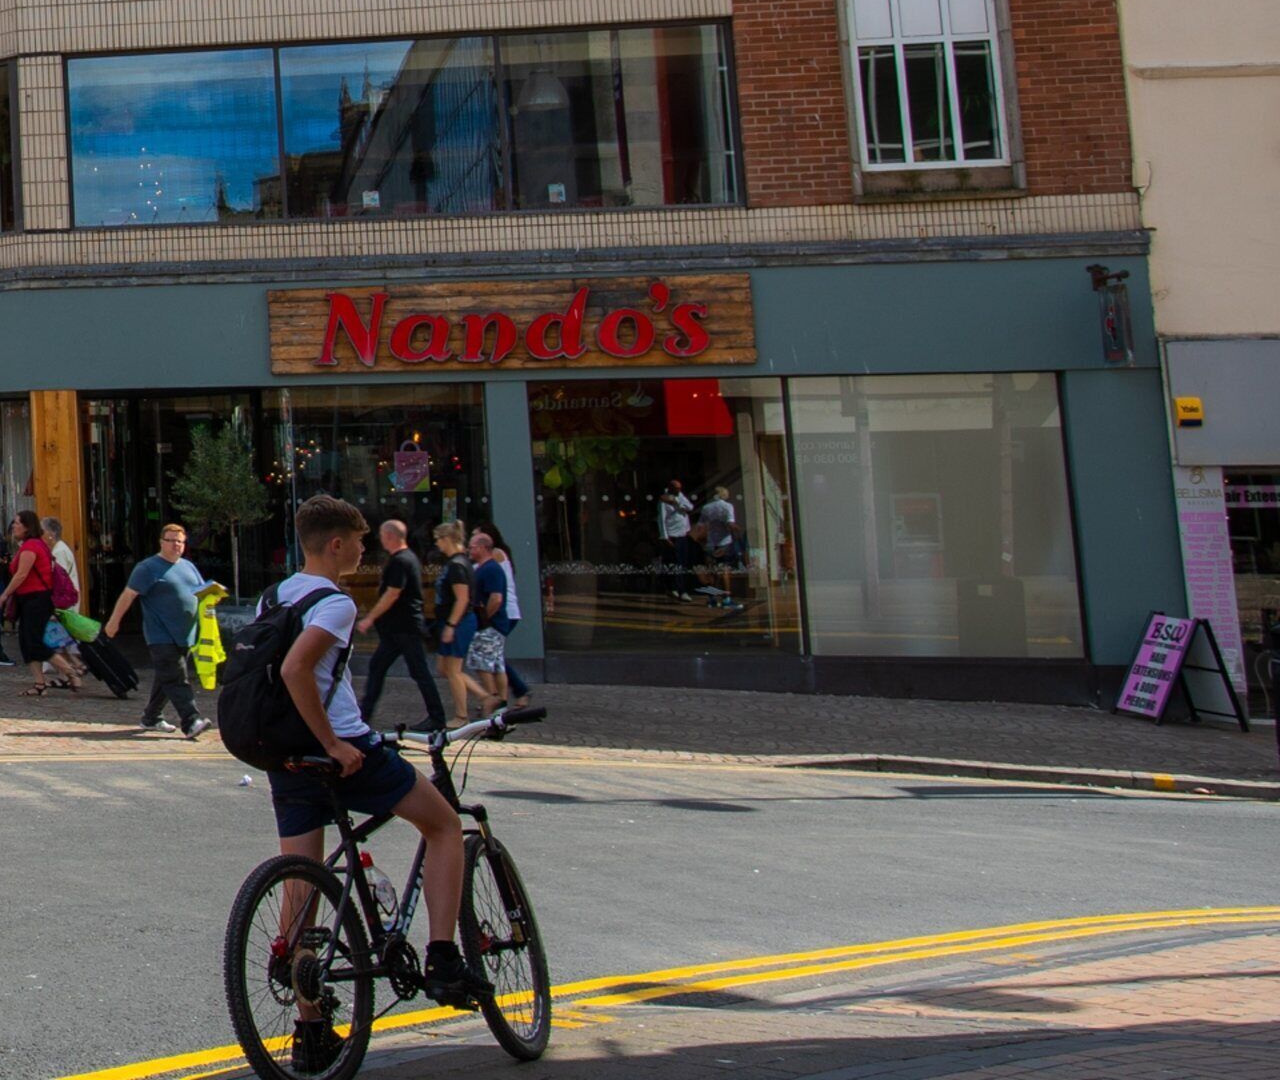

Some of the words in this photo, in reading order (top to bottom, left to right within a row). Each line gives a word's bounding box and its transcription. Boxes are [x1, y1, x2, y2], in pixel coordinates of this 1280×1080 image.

[311, 281, 712, 368] Nando's
[1226, 490, 1240, 502] air
[1150, 652, 1168, 664] HAIR
[1132, 664, 1174, 682] EXTENSIONS
[1140, 682, 1160, 694] BODY
[1124, 694, 1157, 711] PIERCING
